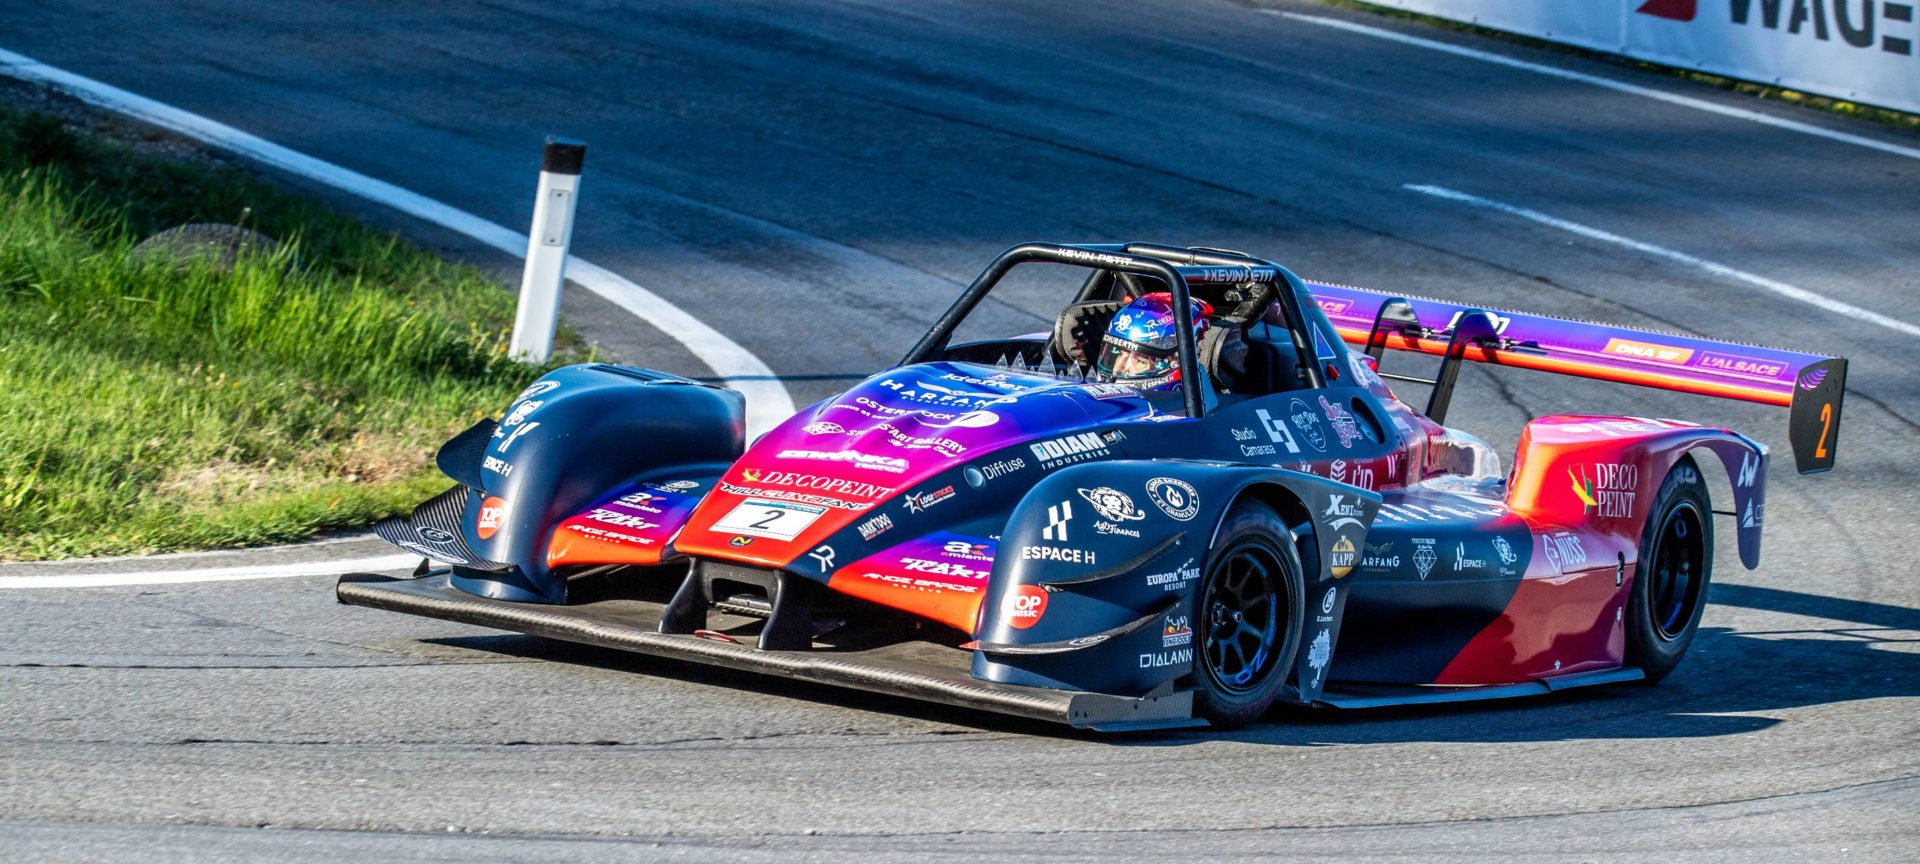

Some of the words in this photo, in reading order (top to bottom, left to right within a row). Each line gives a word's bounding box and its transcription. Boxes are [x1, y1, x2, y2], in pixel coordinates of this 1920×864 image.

[1057, 248, 1096, 262] KEVIN
[1097, 253, 1133, 267] PETIT
[1211, 269, 1243, 282] KEVIN
[1614, 343, 1655, 358] DNA
[1701, 356, 1781, 376] L'ALSACE
[1231, 427, 1257, 441] Studio
[1815, 403, 1832, 458] 2
[1041, 432, 1106, 461] DIAM
[1240, 444, 1276, 457] Camarasa
[982, 456, 1026, 480] Diffuse
[1041, 449, 1110, 470] INDUSTRIES
[761, 471, 896, 499] DECOPEINT
[1596, 463, 1638, 490] DECO
[1597, 491, 1636, 518] PEINT
[749, 510, 786, 529] 2
[1021, 545, 1081, 563] ESPACE
[1084, 551, 1096, 565] H
[1332, 553, 1355, 566] KAPP
[1555, 536, 1586, 566] NUSS
[1360, 555, 1400, 567] ARFANG
[1463, 559, 1482, 568] ESPACE
[1146, 571, 1179, 586] EUROPA
[1182, 567, 1201, 580] PARK
[1164, 581, 1187, 591] RESORT
[1139, 648, 1193, 668] DIALANN
